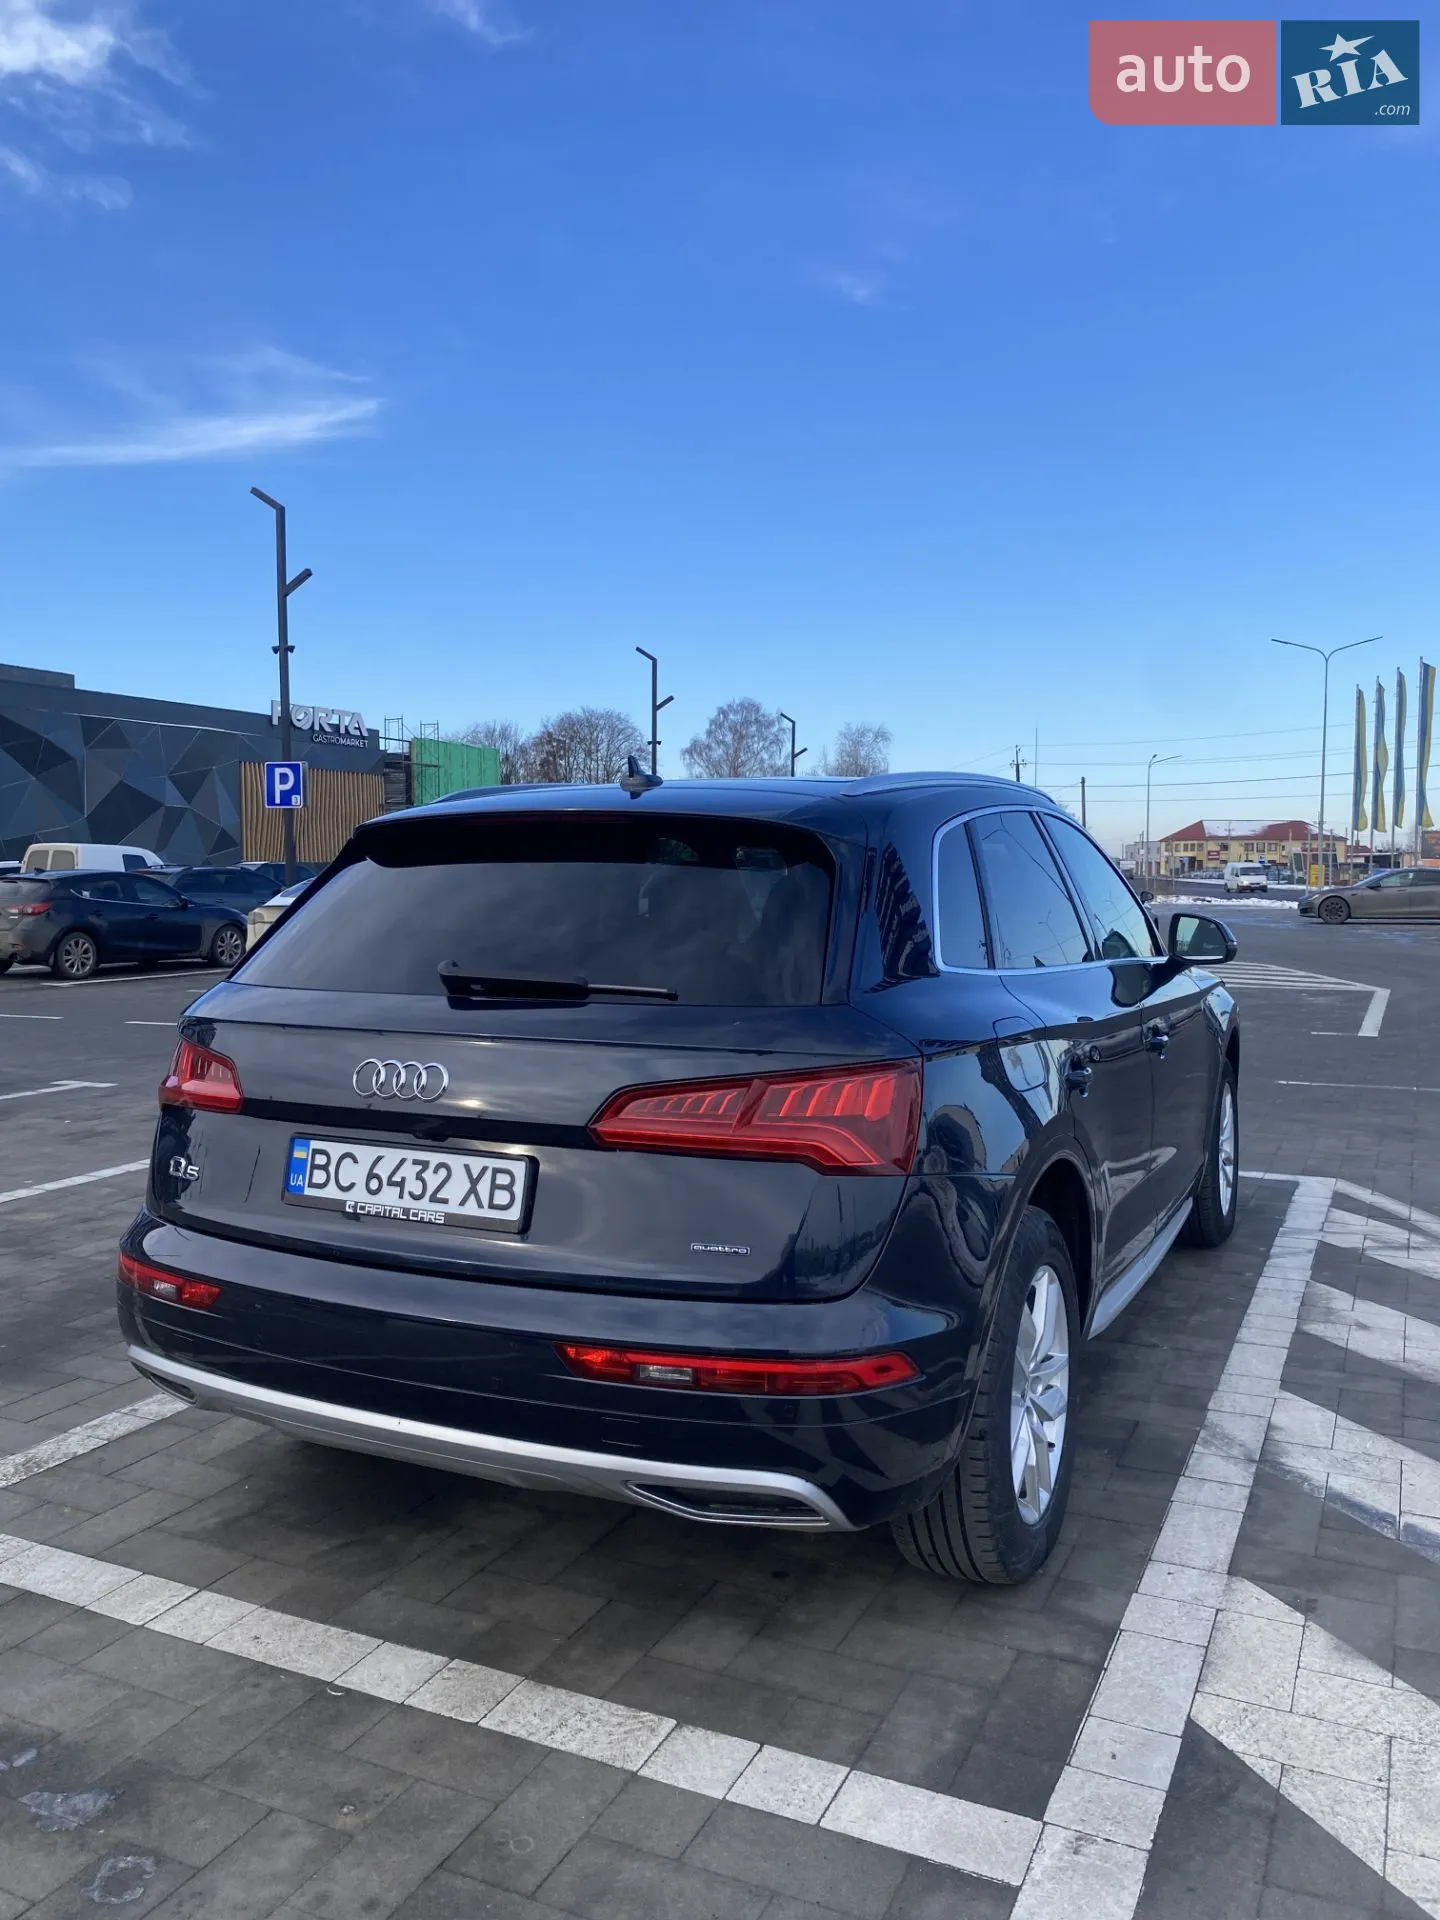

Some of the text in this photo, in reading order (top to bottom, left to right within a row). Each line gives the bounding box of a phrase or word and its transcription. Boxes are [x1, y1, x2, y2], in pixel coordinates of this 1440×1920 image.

[312, 733, 369, 748] GASTROMARKET
[274, 767, 295, 804] P
[169, 1155, 199, 1180] Q5
[290, 1173, 304, 1188] UA
[365, 1154, 453, 1205] 6432
[357, 1202, 445, 1224] CAPITAL CARS
[693, 1245, 747, 1254] quattro
